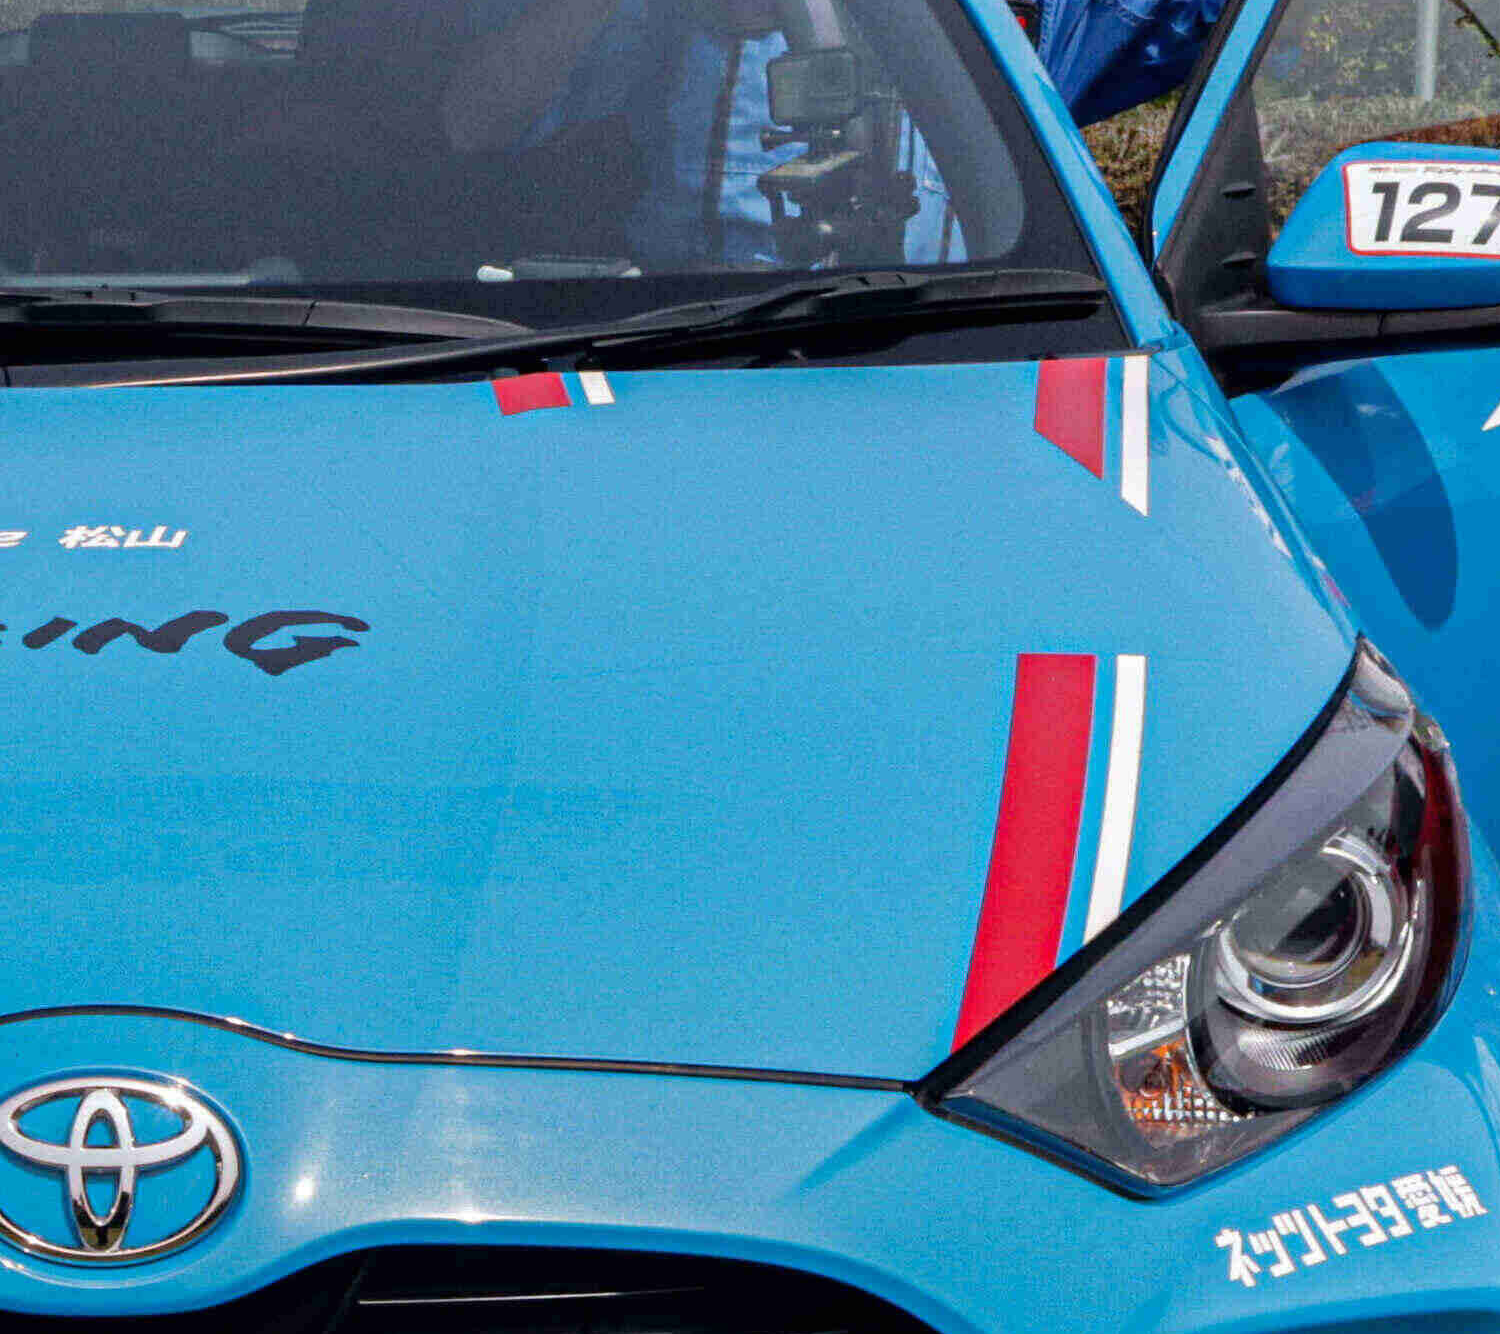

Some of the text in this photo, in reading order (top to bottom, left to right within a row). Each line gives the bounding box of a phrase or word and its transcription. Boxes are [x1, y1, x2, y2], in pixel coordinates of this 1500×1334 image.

[57, 524, 189, 550] 松山
[1213, 1164, 1489, 1288] ネッツトヨタ愛媛
